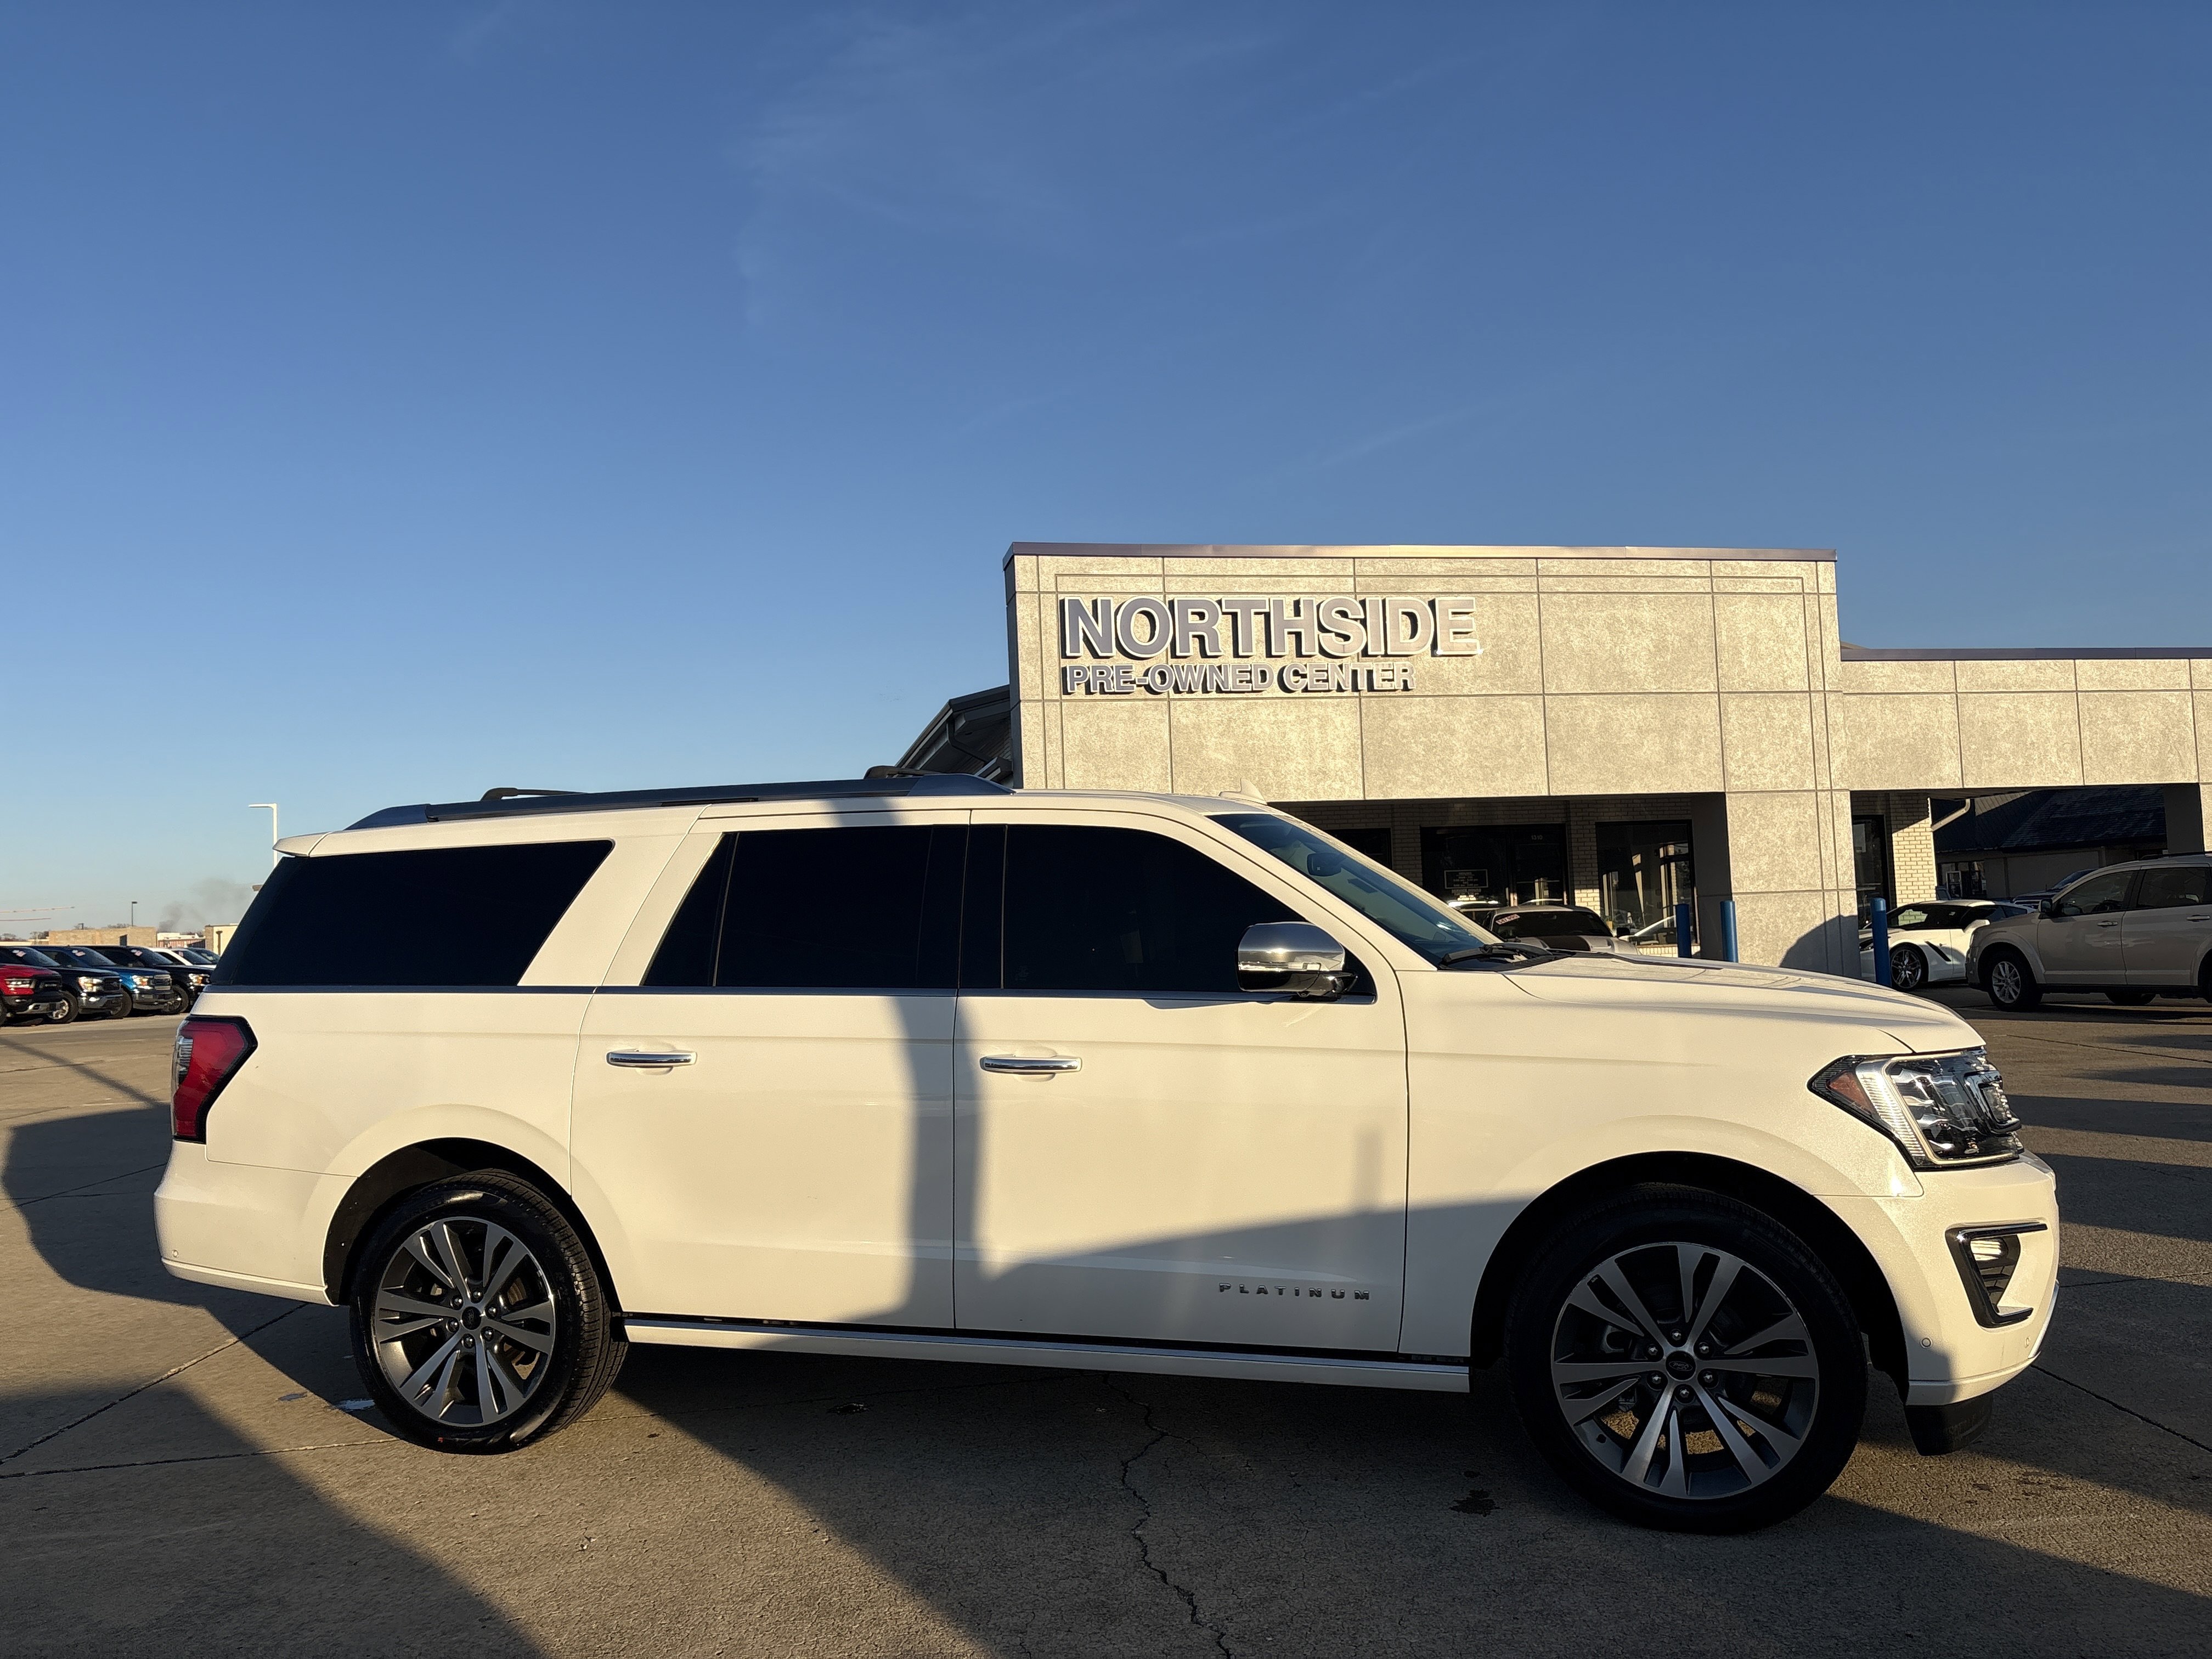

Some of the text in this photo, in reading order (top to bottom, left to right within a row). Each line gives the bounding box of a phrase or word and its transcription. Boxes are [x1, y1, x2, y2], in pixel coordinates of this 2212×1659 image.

[1061, 595, 1480, 659] NORTHSIDE
[1063, 662, 1417, 694] PRE-OWNED CENTER
[1219, 1282, 1369, 1300] PLATINUM
